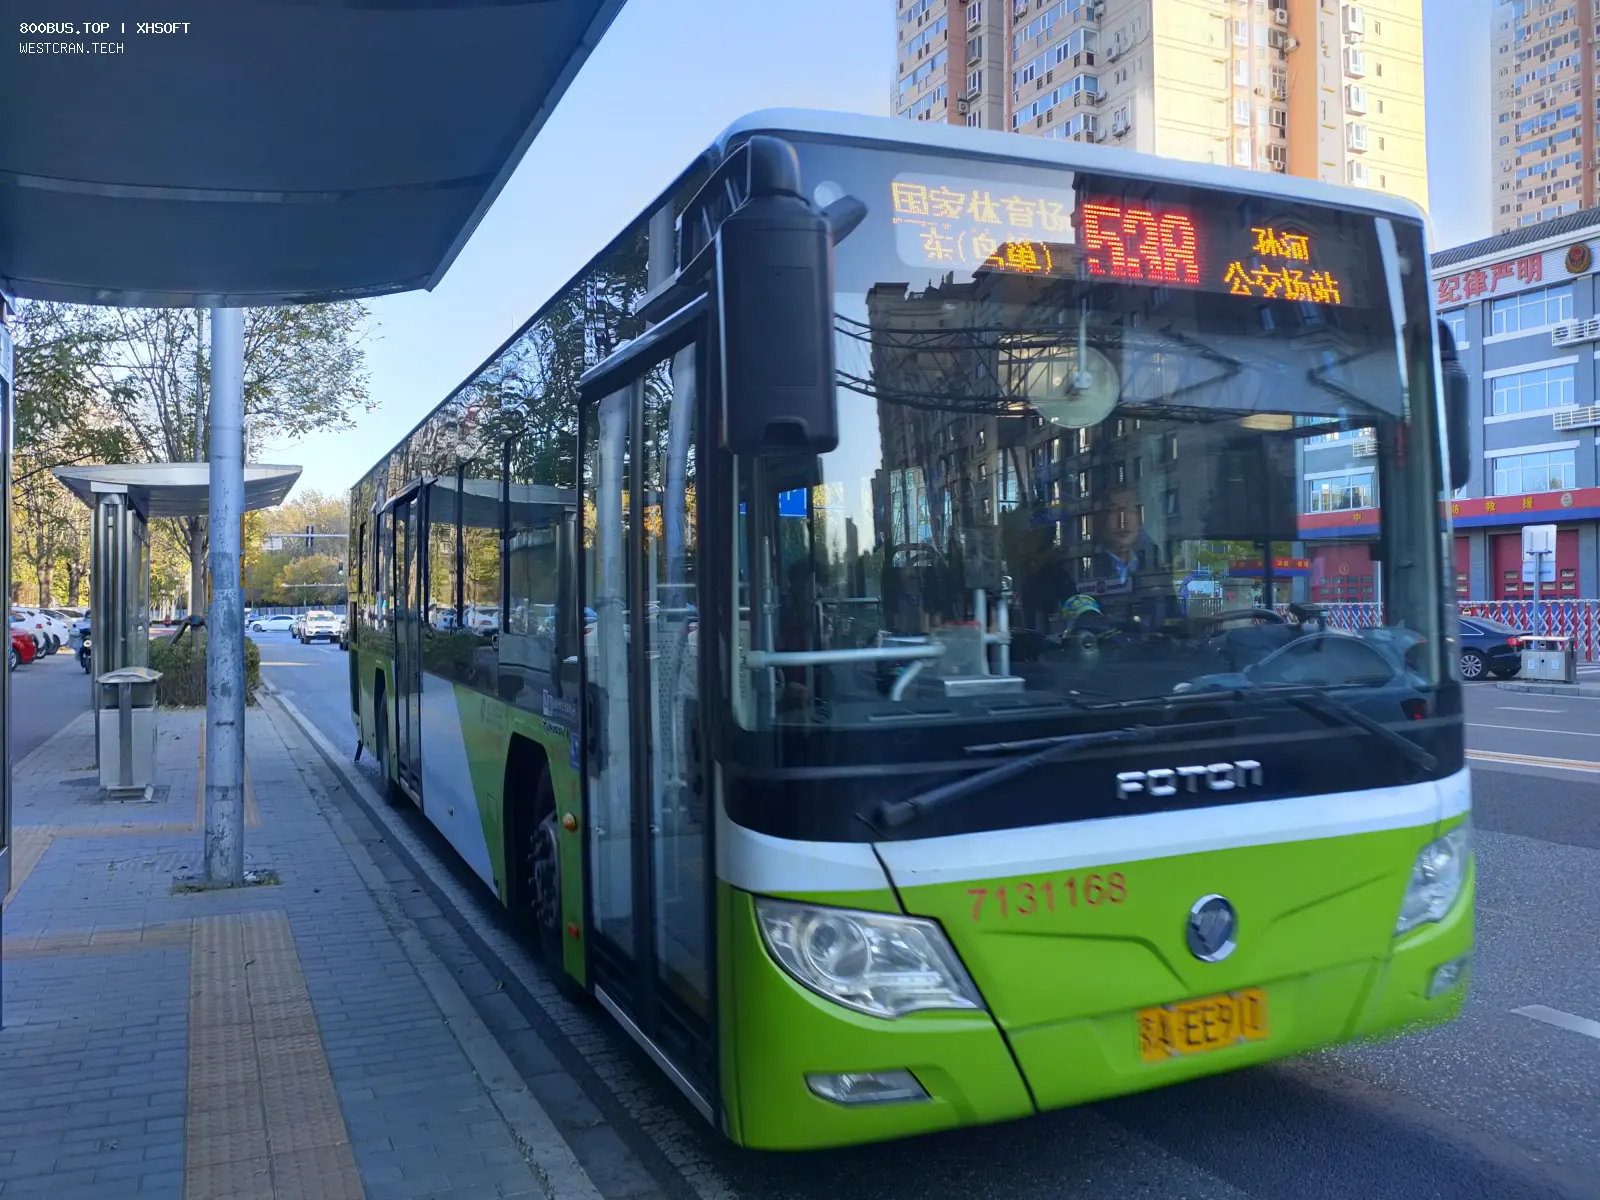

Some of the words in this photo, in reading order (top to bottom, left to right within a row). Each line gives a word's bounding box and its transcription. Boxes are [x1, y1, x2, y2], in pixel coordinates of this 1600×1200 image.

[1251, 227, 1310, 264] 孙河
[1224, 261, 1341, 305] 公交场站
[1437, 254, 1543, 305] 纪律严明
[1116, 759, 1263, 800] FOTON
[967, 871, 1128, 922] 7131168
